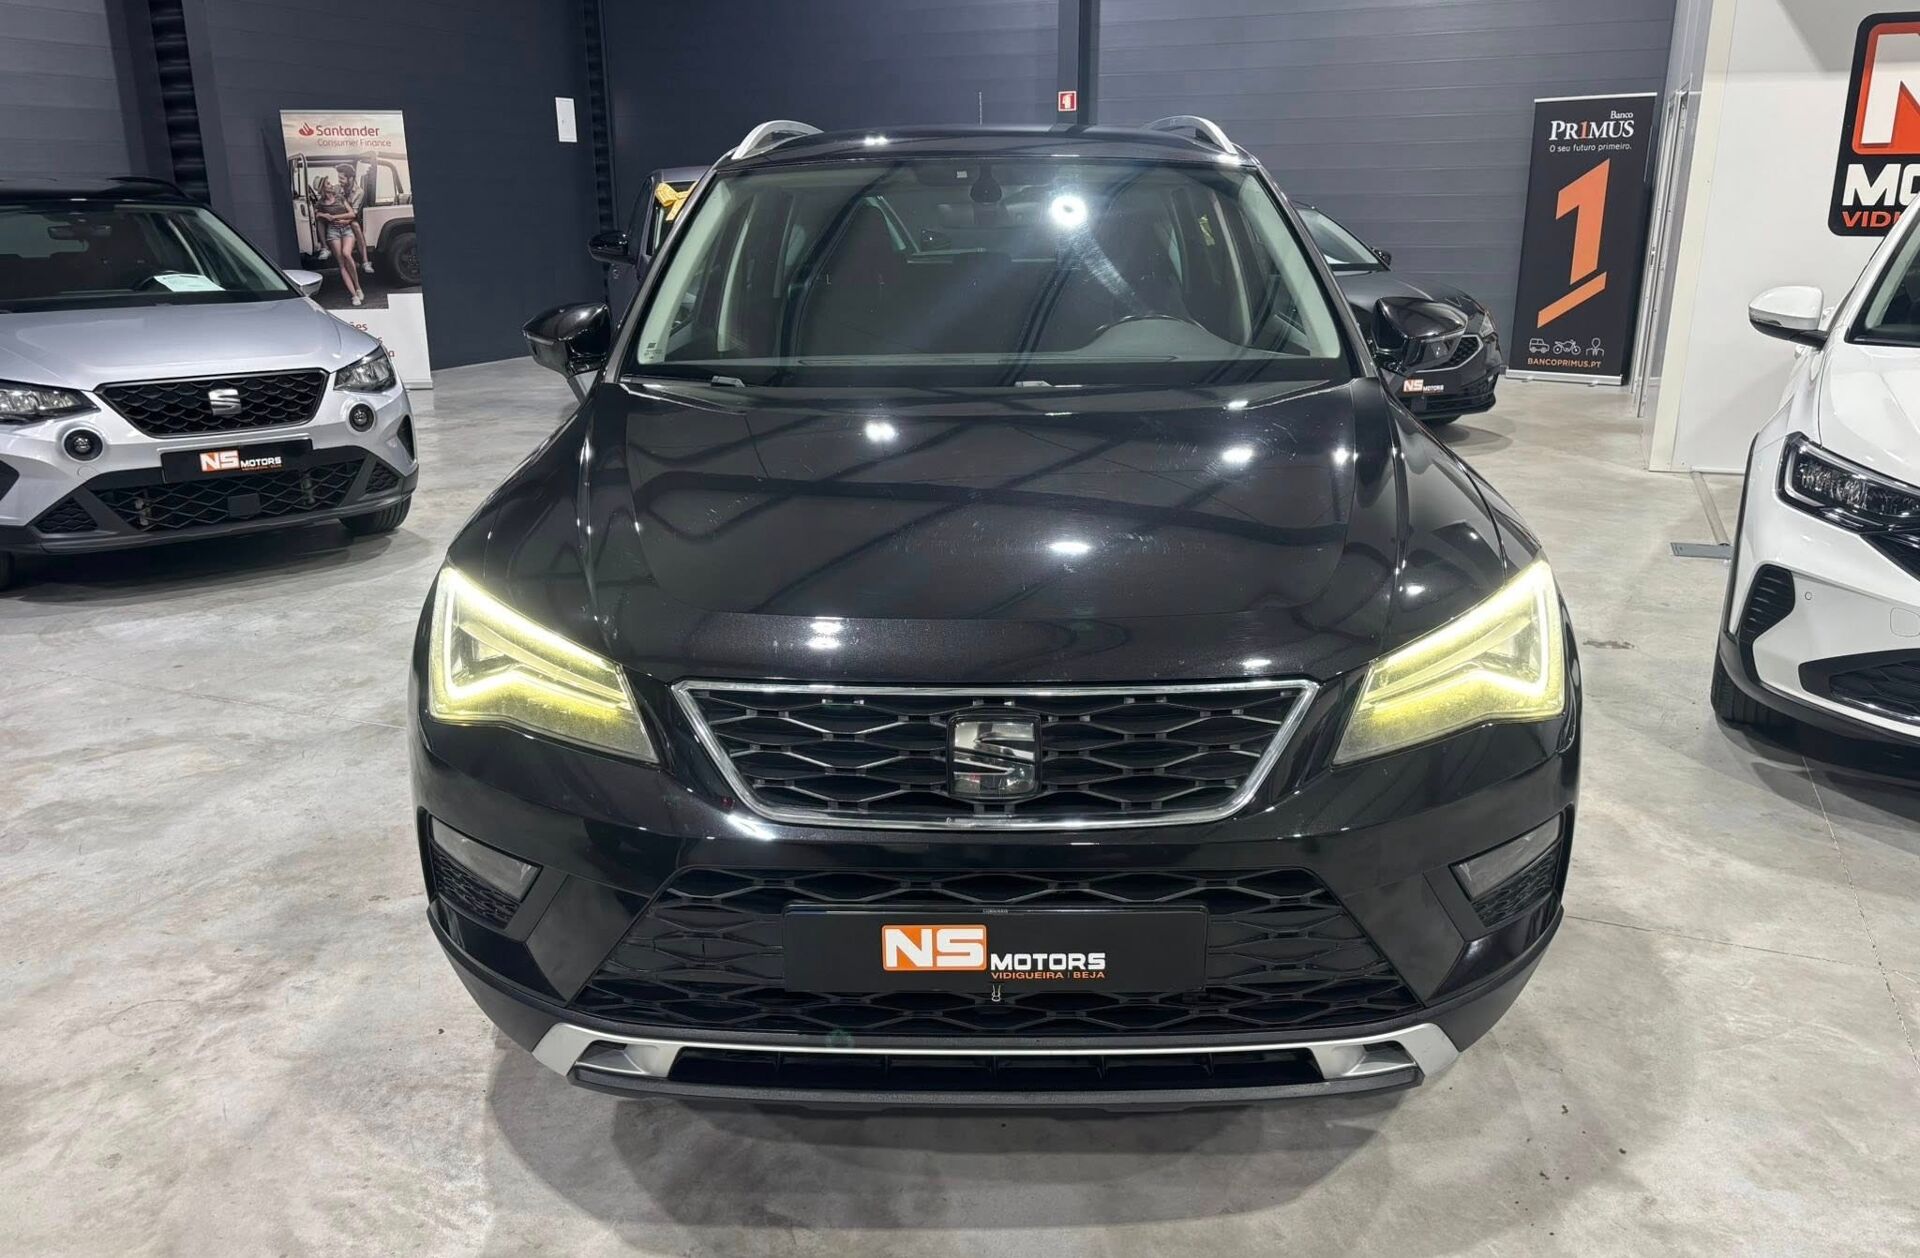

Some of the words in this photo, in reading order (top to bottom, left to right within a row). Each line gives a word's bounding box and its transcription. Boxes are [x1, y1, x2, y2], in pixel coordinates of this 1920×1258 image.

[1610, 110, 1634, 119] Banco
[316, 125, 380, 136] Santander
[317, 139, 358, 147] Consumer
[360, 139, 391, 147] Finance
[1549, 144, 1556, 153] O
[1573, 143, 1596, 152] futuro
[1597, 143, 1632, 152] primeiro.
[1527, 358, 1602, 368] BANCOPRIMUS.PT
[1403, 379, 1424, 392] NS
[200, 450, 239, 471] NS
[240, 456, 282, 468] MOTORS
[884, 928, 984, 968] NS
[990, 953, 1106, 971] MOTORS
[991, 972, 1064, 980] VIDIGUEIRA
